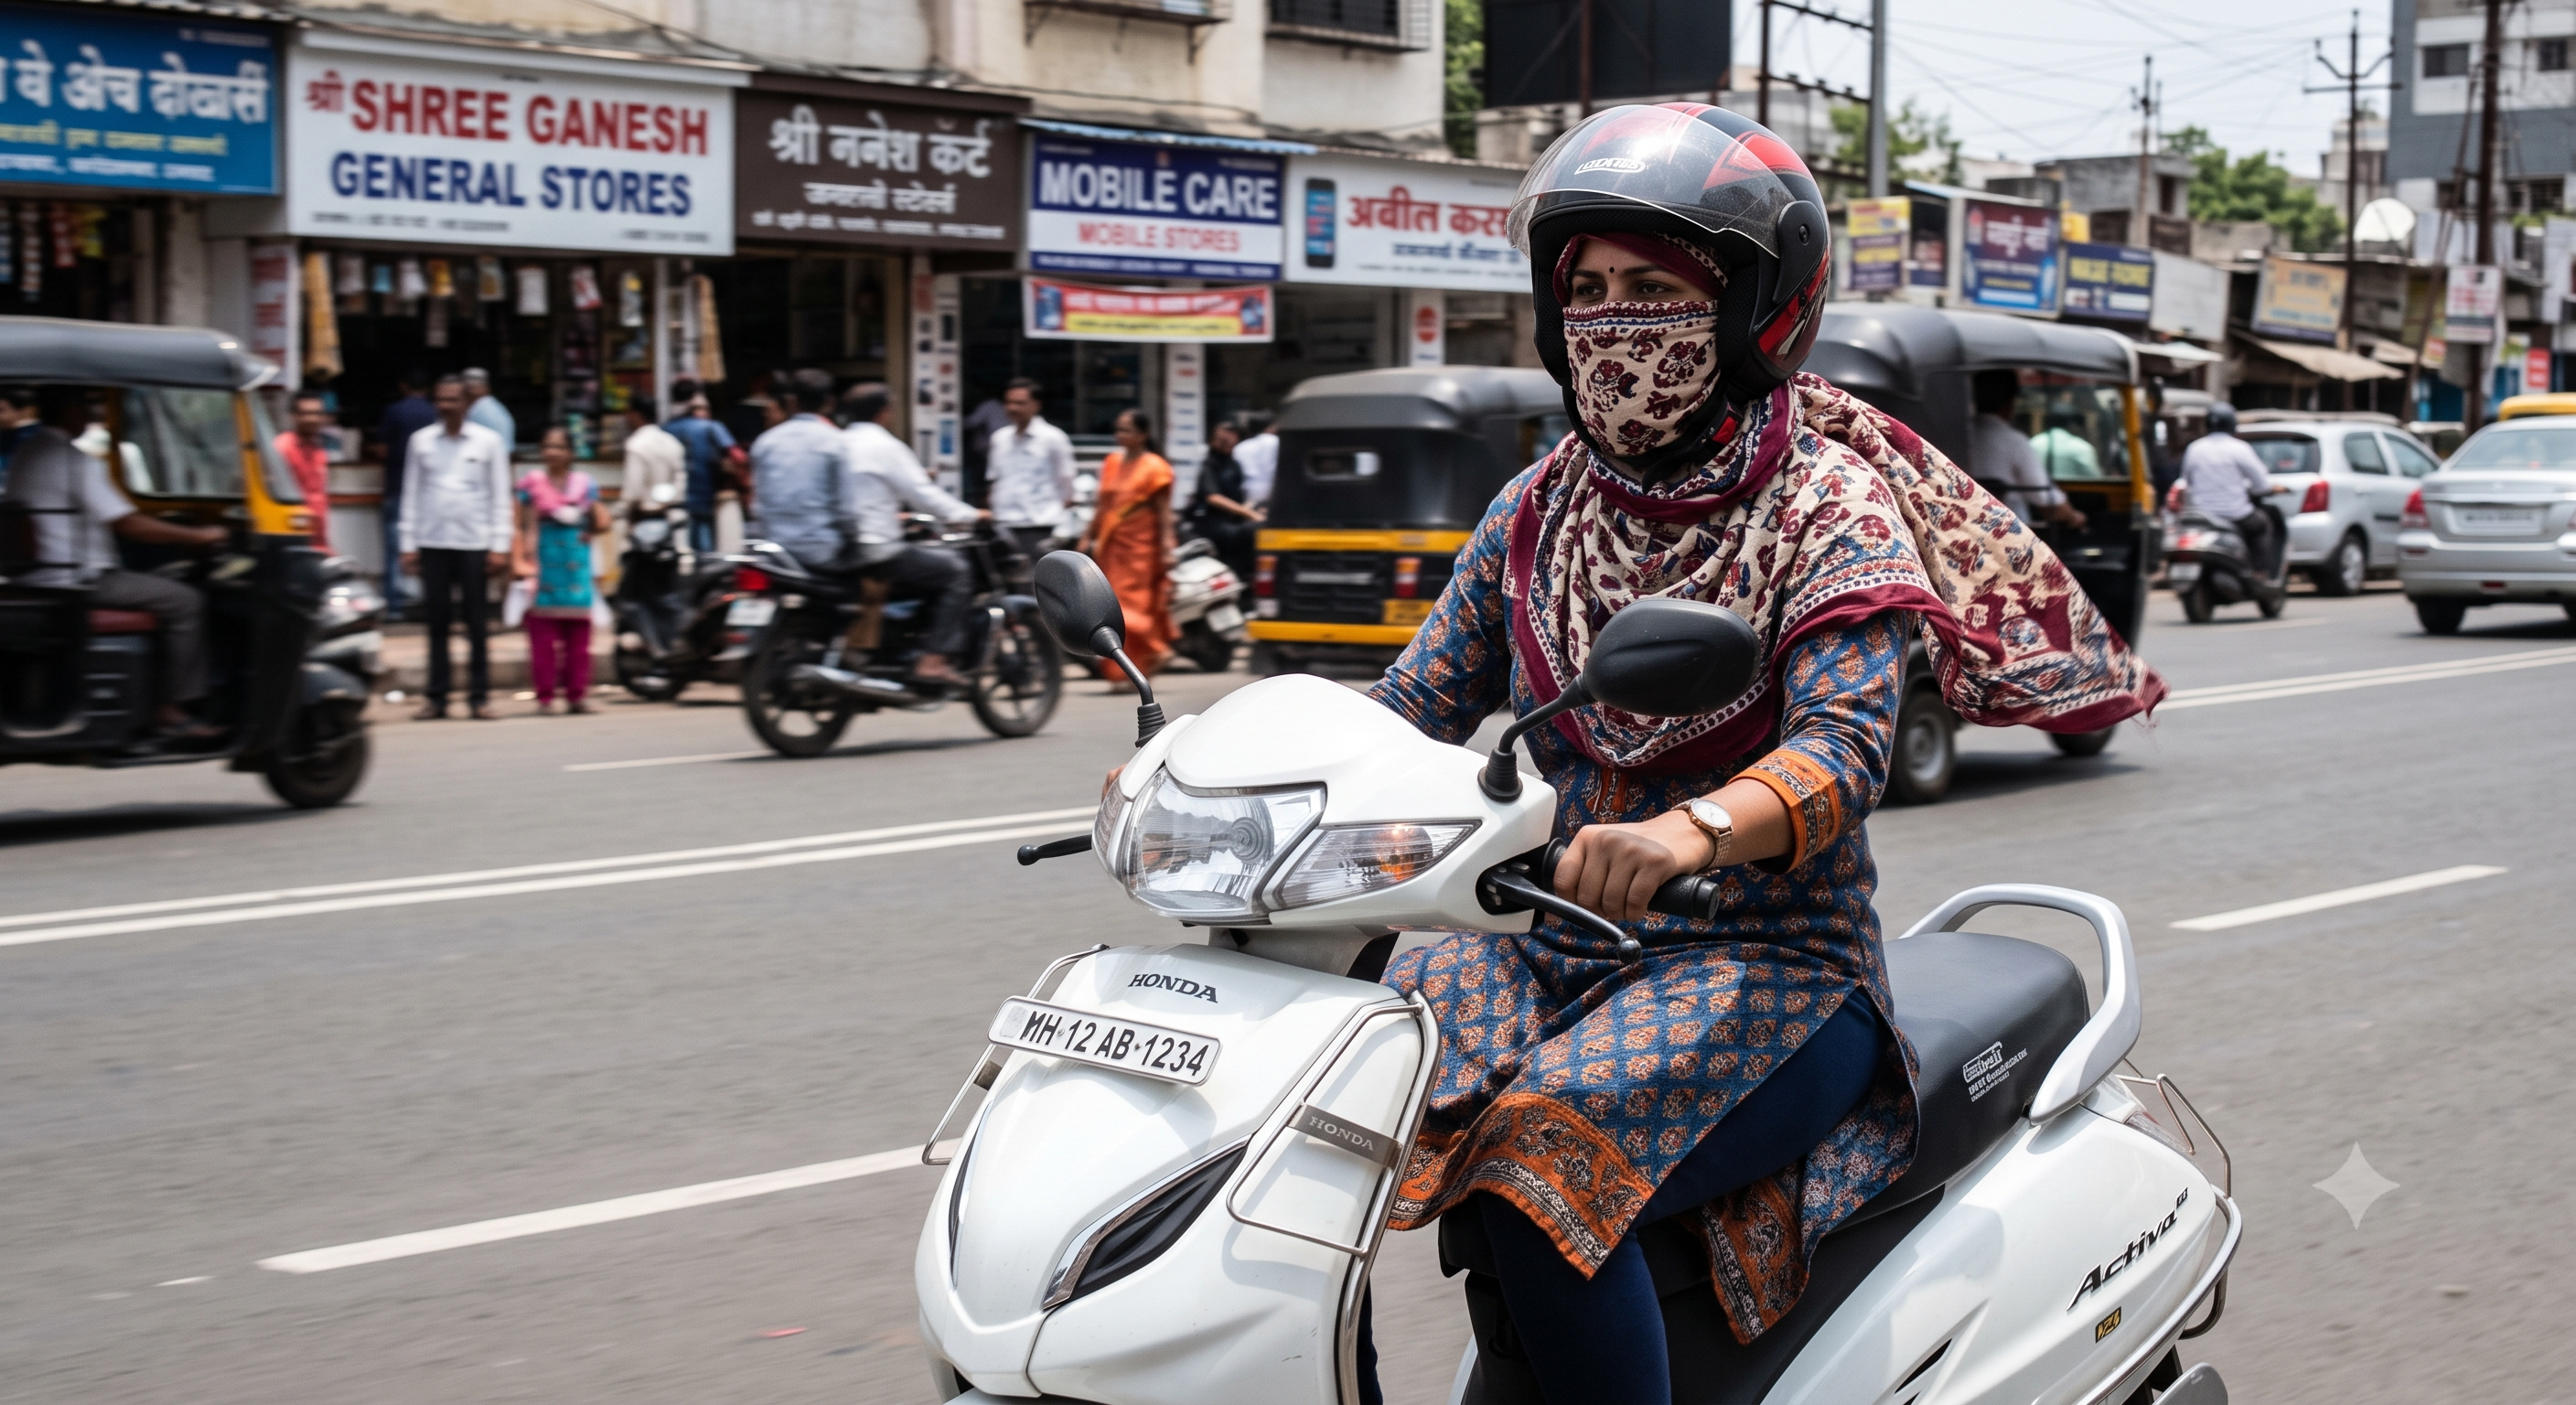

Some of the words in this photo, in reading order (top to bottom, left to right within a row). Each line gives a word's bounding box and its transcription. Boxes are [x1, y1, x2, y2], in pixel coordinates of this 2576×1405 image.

[351, 79, 510, 142] SHREE
[526, 94, 709, 156] GANESH
[768, 103, 821, 166] श्री
[330, 151, 526, 208] GENERAL
[541, 165, 692, 217] STORES
[1039, 161, 1178, 213] MOBILE
[1184, 172, 1278, 220] CARE
[1078, 221, 1158, 249] MOBILE
[1165, 226, 1240, 252] STORES
[1128, 973, 1218, 1003] HONDA
[1020, 1011, 1063, 1046] MH
[1064, 1019, 1098, 1053] 12
[1094, 1026, 1135, 1060] AB
[1142, 1035, 1209, 1077] 1234
[1309, 1116, 1374, 1152] HONDA
[2066, 1209, 2177, 1312] Activa
